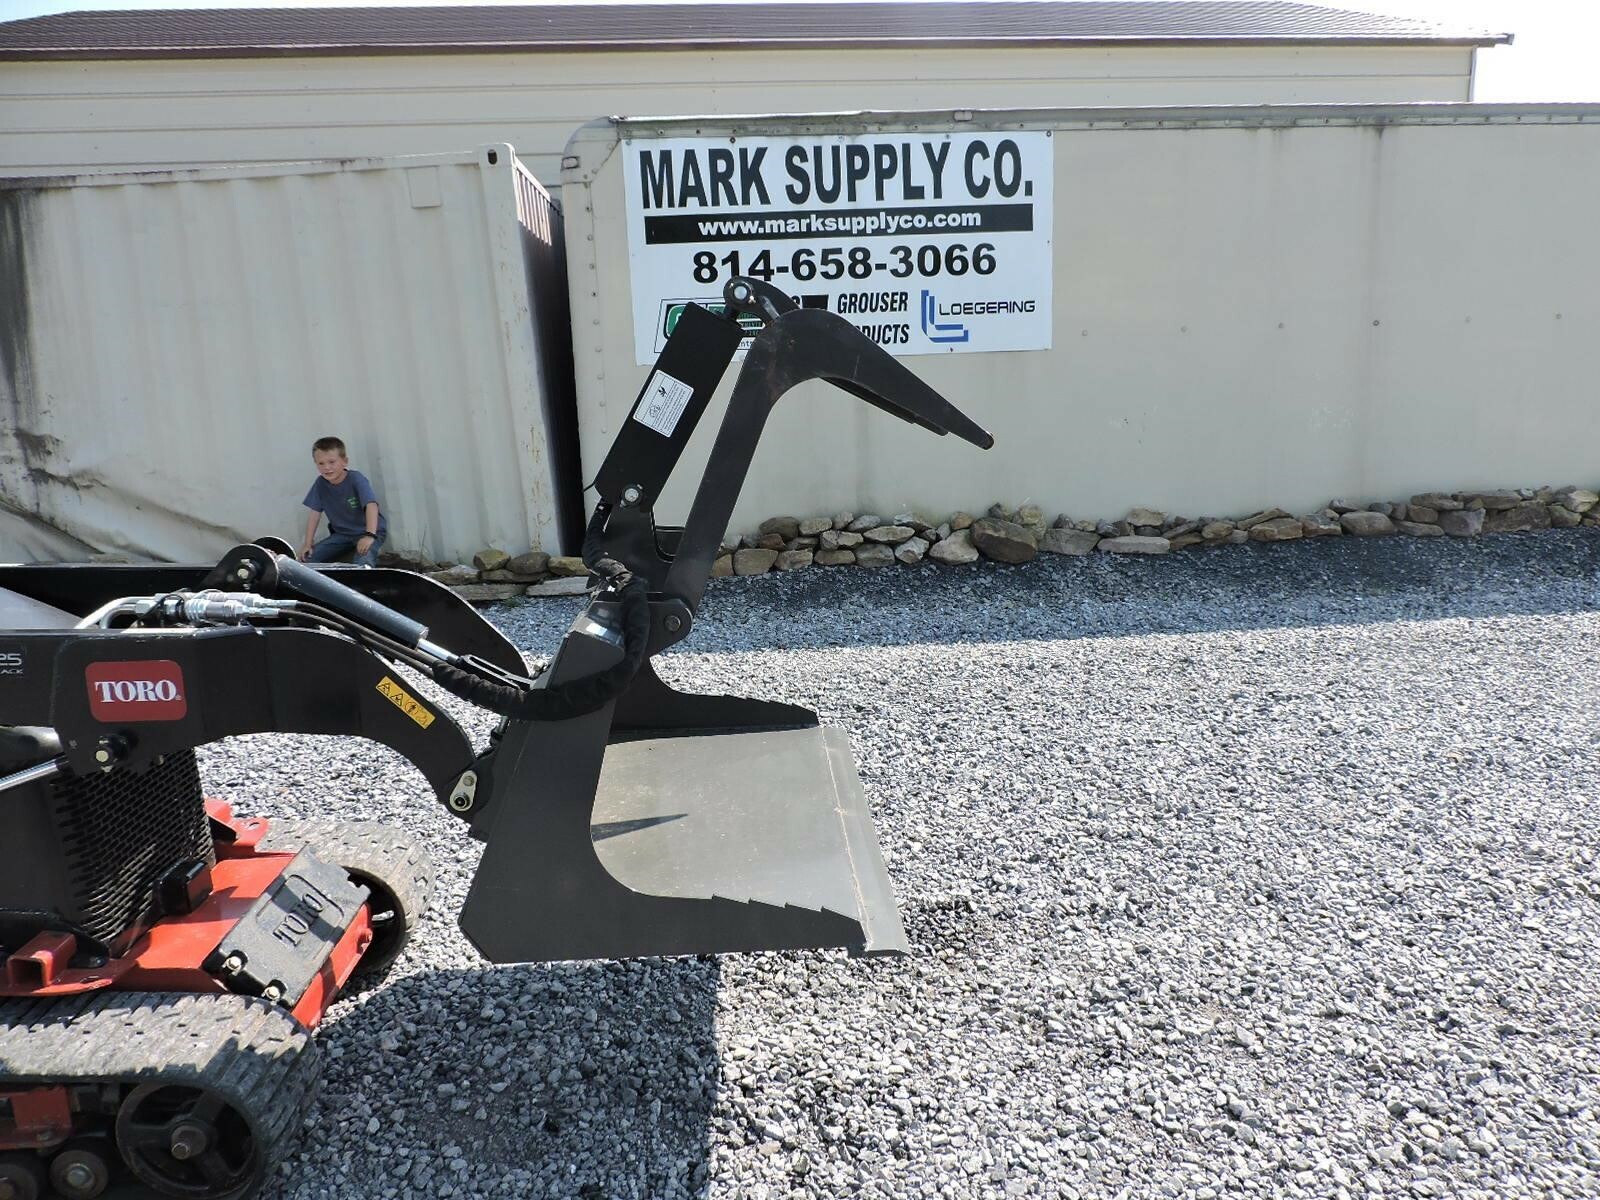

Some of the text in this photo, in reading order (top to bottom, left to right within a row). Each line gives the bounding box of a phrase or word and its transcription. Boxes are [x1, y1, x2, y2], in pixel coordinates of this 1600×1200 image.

[639, 139, 1033, 209] MARK SUPPLY CO.
[698, 212, 982, 235] www.marksupplyco.com
[693, 243, 997, 283] 814-658-3066
[837, 292, 909, 313] GROUSER
[938, 300, 1036, 315] LOEGERING
[855, 323, 910, 345] DUCTS
[94, 679, 177, 703] TORO
[272, 893, 325, 948] TORO
